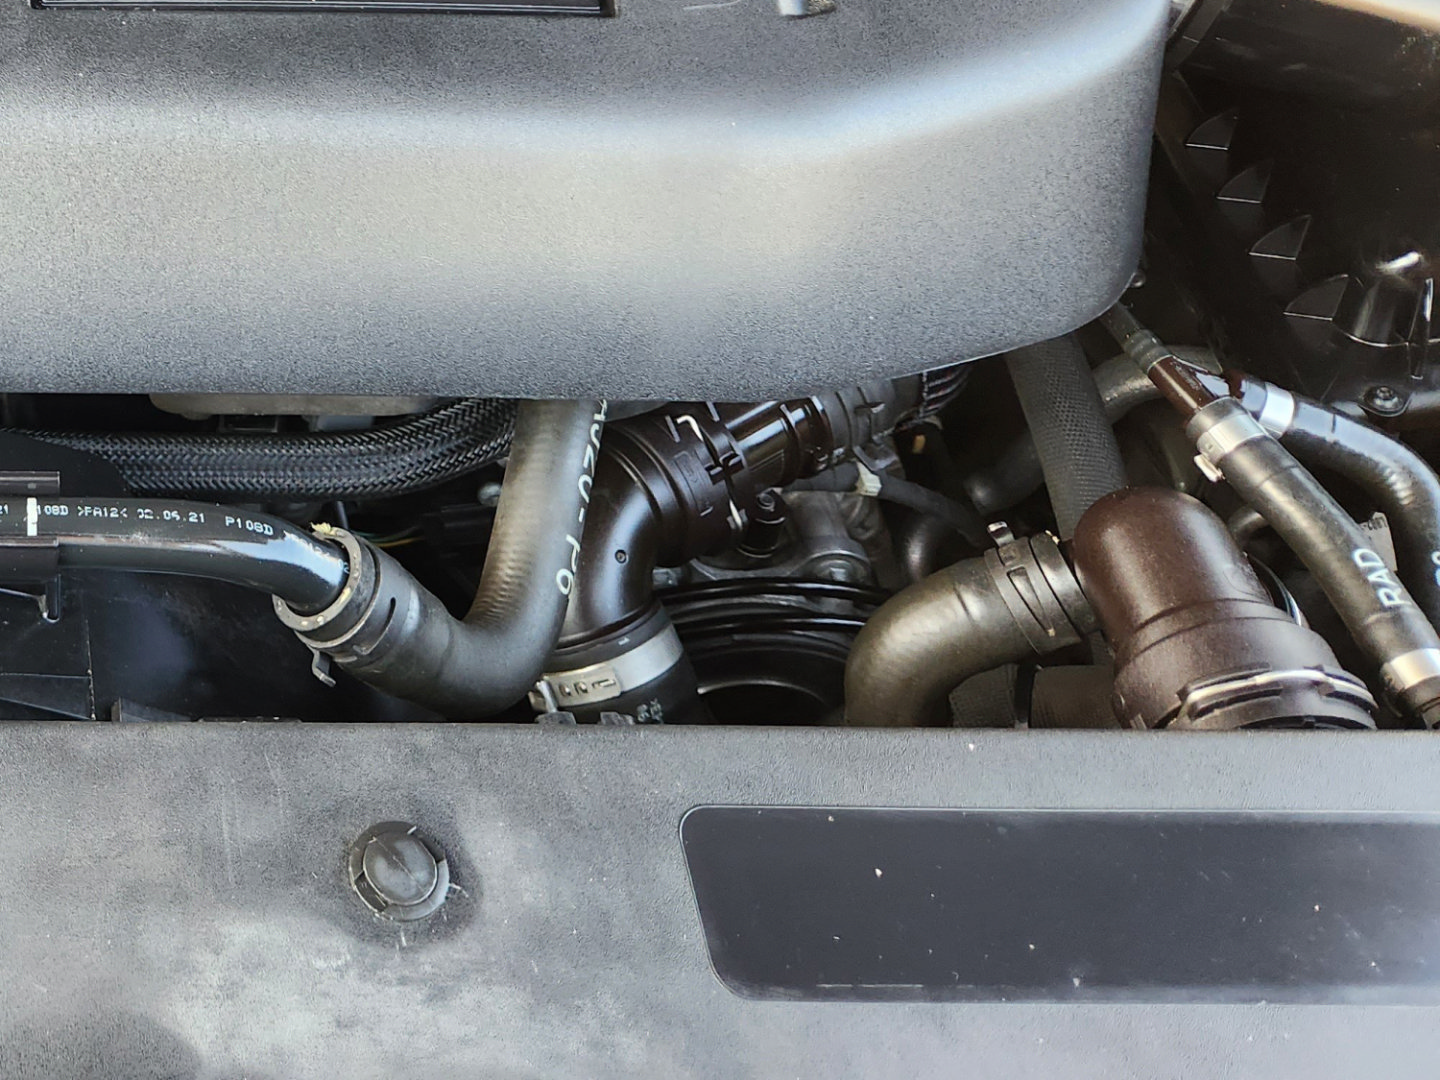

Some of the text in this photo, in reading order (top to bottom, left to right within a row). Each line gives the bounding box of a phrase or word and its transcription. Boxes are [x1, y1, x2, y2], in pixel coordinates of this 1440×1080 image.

[35, 504, 69, 516] 108D
[225, 516, 274, 536] P108D
[1352, 548, 1412, 609] RAD
